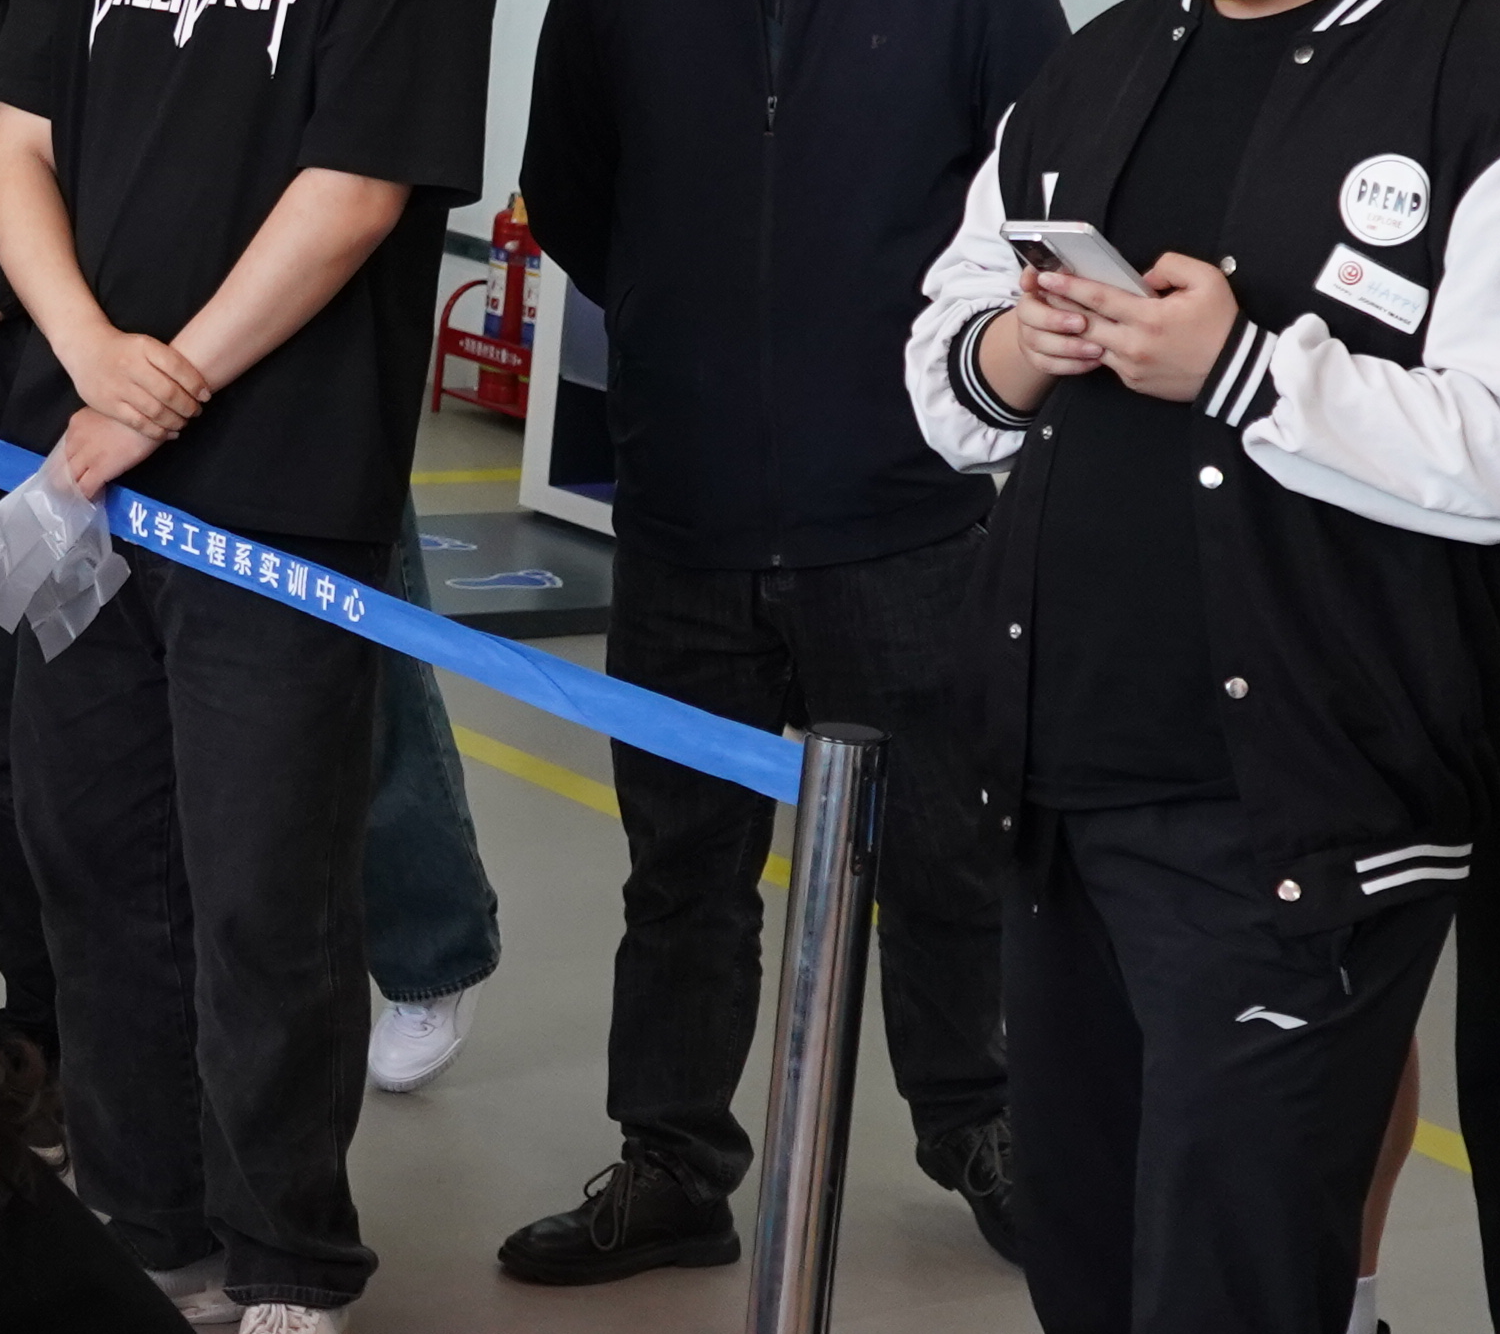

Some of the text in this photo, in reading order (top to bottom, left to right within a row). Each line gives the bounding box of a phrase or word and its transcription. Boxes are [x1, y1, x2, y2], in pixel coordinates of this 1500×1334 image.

[129, 501, 366, 623] 化学工程系实训中心
